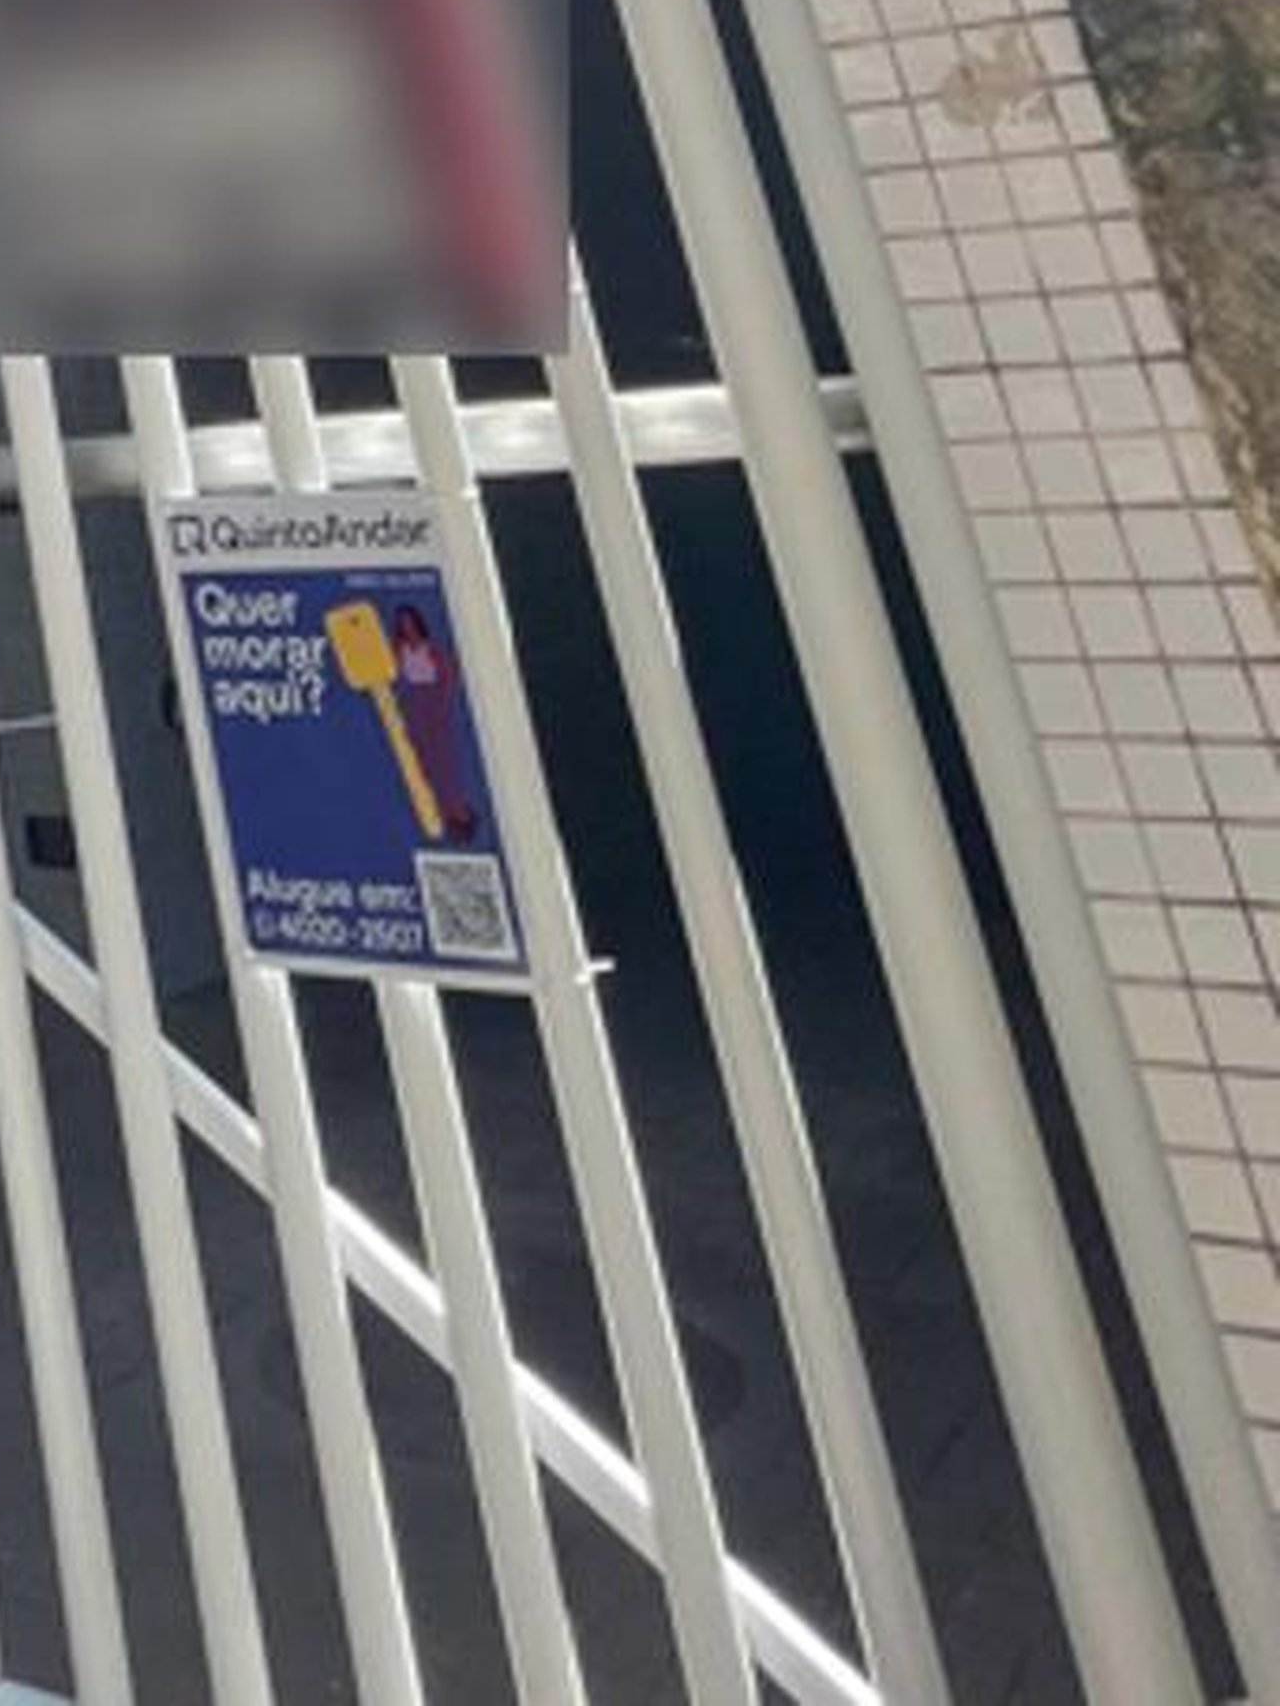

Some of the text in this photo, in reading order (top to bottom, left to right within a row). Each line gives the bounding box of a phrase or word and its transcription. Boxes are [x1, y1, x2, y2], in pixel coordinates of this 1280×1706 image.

[211, 512, 430, 550] QuintoAndar
[194, 582, 299, 627] Quer
[203, 635, 326, 670] morar
[213, 668, 326, 725] aqui?
